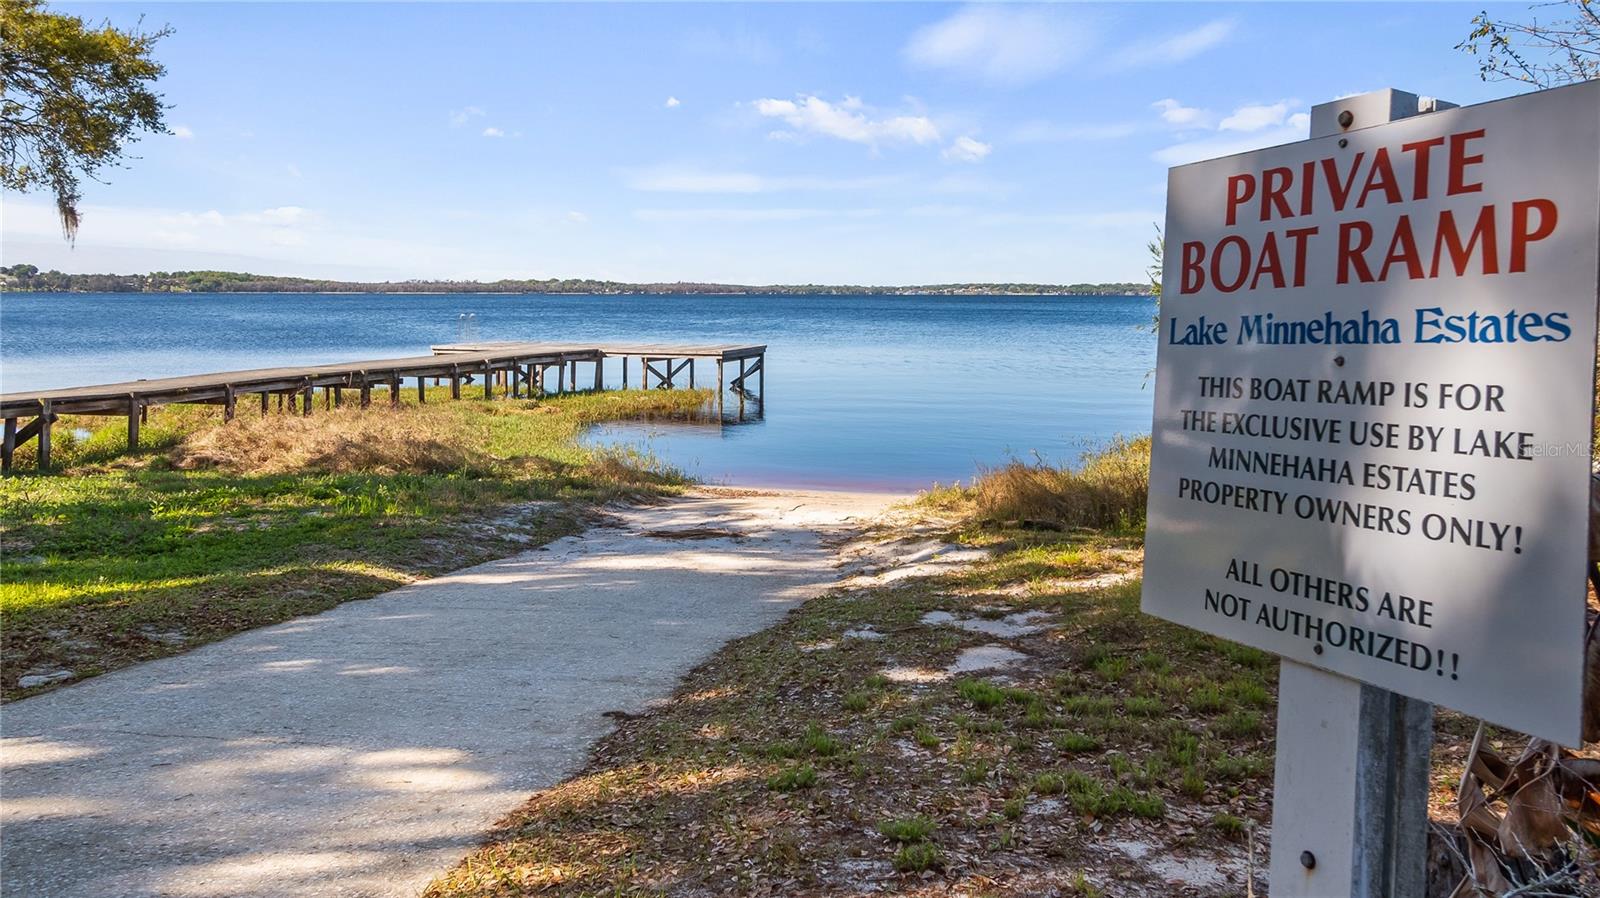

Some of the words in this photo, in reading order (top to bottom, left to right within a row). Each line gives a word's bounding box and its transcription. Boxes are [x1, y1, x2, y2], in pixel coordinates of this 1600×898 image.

[1225, 129, 1486, 226] PRIVATE
[1180, 226, 1319, 294] BOAT
[1336, 199, 1558, 284] RAMP
[1169, 315, 1228, 345] Lake
[1237, 310, 1401, 345] Minnehaha
[1414, 307, 1571, 344] Estates
[1198, 376, 1243, 400] THIS
[1250, 378, 1311, 402] BOAT
[1317, 380, 1395, 406] RAMP
[1404, 383, 1428, 408] IS
[1439, 384, 1505, 412] FOR
[1181, 410, 1216, 433] THE
[1222, 413, 1342, 444] EXCLUSIVE
[1350, 421, 1399, 449] USE
[1408, 425, 1444, 452] BY
[1454, 428, 1534, 461] LAKE
[1208, 447, 1355, 486] MINNEHAHA
[1363, 463, 1475, 500] ESTATES
[1178, 477, 1288, 515] PROPERTY
[1294, 495, 1412, 535] OWNERS
[1422, 513, 1523, 554] ONLY!
[1225, 559, 1263, 587] ALL
[1270, 568, 1369, 613] OTHERS
[1377, 592, 1433, 628] ARE
[1205, 589, 1251, 621] NOT
[1256, 602, 1460, 682] AUTHORIZED!!
